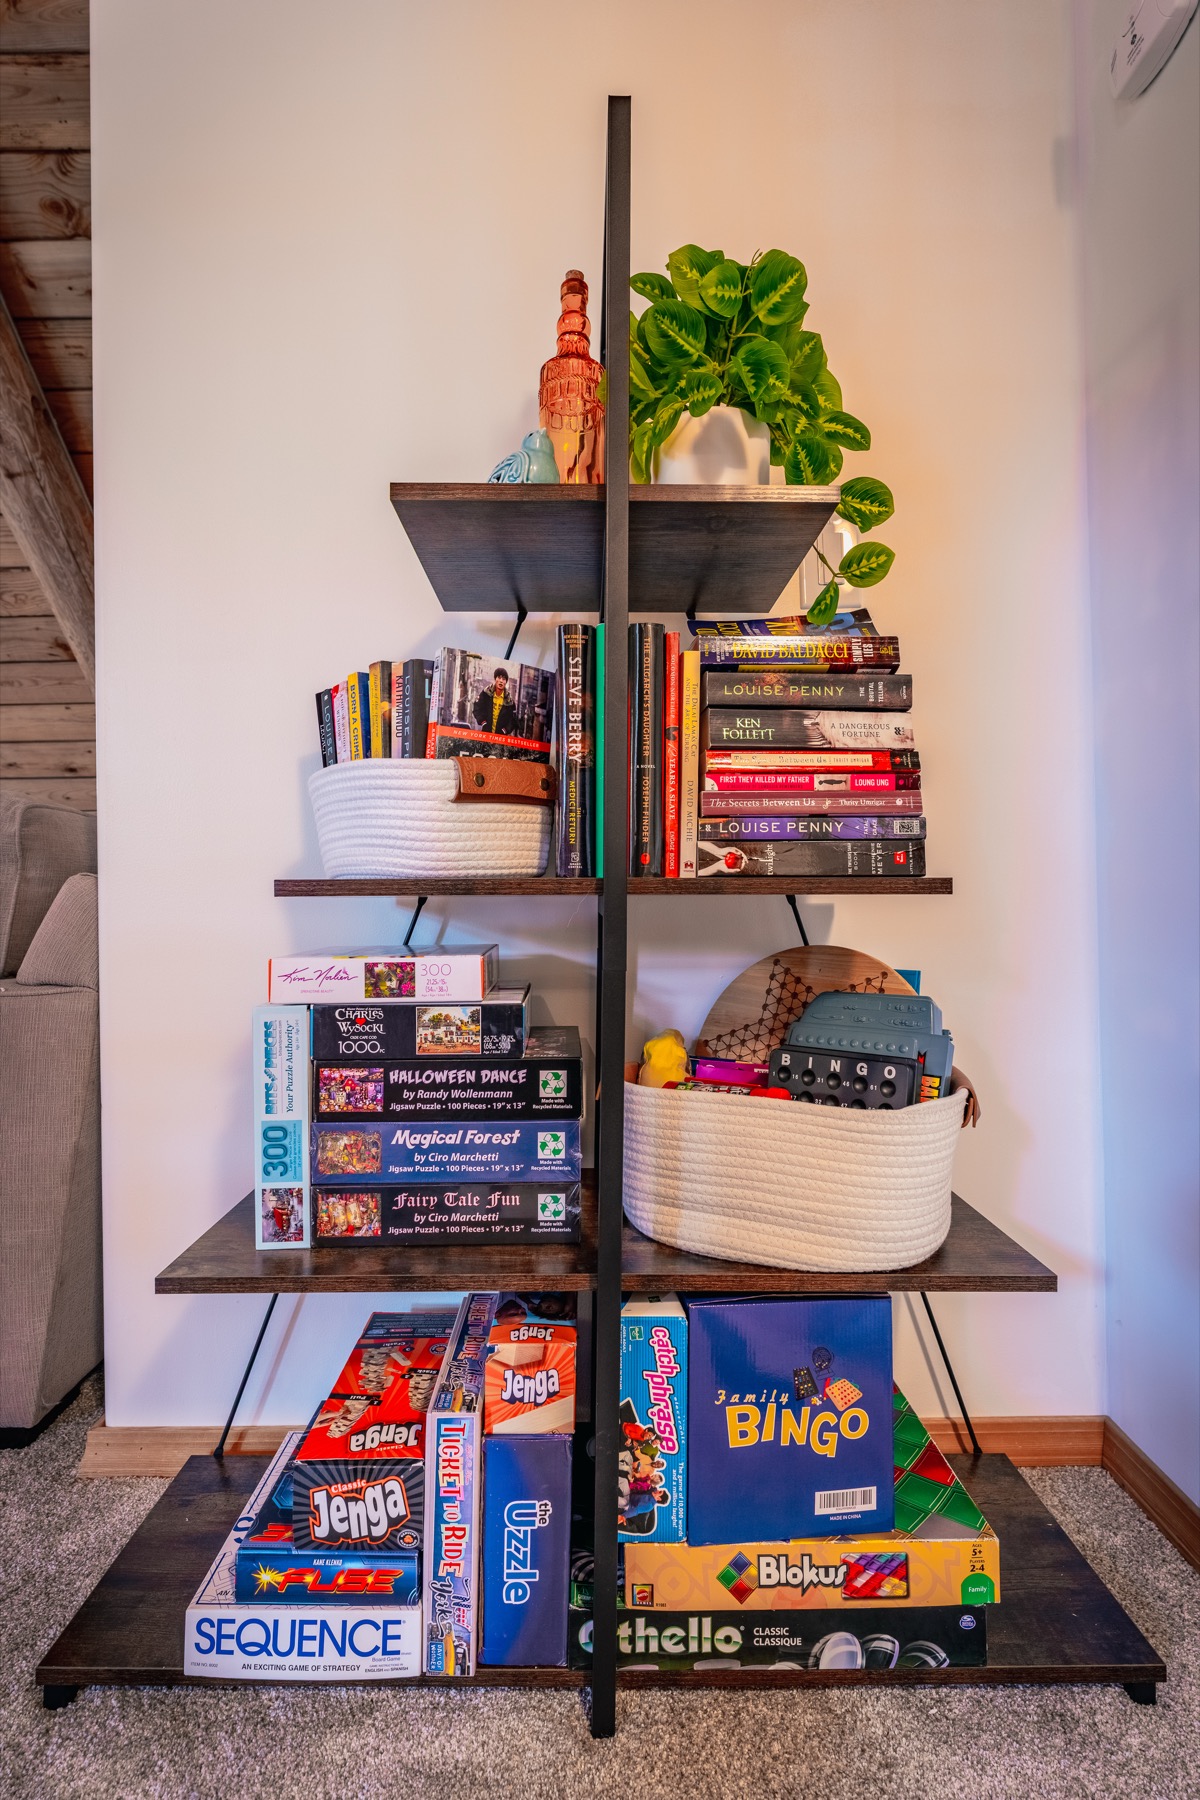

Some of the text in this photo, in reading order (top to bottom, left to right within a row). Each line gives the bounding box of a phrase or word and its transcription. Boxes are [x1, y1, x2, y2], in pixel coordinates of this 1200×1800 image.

[733, 642, 777, 658] DAVID
[778, 642, 849, 658] BALDACCI
[852, 638, 863, 662] SIMPLY
[863, 643, 873, 658] LIES
[643, 637, 651, 757] THE OLIGARCH'S DAUGHTER
[724, 684, 845, 697] LOUISE PENNY
[350, 684, 358, 714] BORN
[395, 674, 404, 739] KATHMANDU
[568, 656, 582, 763] STEVE BERRY
[352, 717, 358, 725] A
[736, 718, 762, 729] KEN
[831, 723, 890, 731] A DANGEROUS
[453, 729, 540, 749] NEW YORK TIMES BESTSELLER
[723, 728, 776, 741] FOLLETT
[842, 731, 881, 740] FORTUNE
[719, 776, 737, 784] FIRST
[739, 776, 754, 784] THEY
[755, 776, 776, 784] KILLED
[855, 778, 889, 787] LOUNG UNG
[642, 776, 651, 843] JOSEPH FINDER
[710, 798, 816, 807] The Secrets Between Us
[569, 780, 577, 844] MEDICI RETURN
[719, 821, 845, 833] LOUISE PENNY
[420, 963, 452, 977] 300
[263, 1021, 278, 1115] BITS PIECES
[389, 1069, 528, 1085] HALLOWEEN DANCE
[403, 1089, 513, 1100] by Randy Wollenmann
[391, 1130, 521, 1149] Magical Forest
[262, 1126, 289, 1178] 300
[414, 1152, 499, 1164] by Ciro Marchetti
[388, 1165, 413, 1173] Jigsaw
[415, 1165, 440, 1173] Puzzle
[446, 1165, 459, 1173] 100
[392, 1191, 521, 1210] Fairy Tale Fun
[414, 1212, 499, 1224] by Ciro Marchetti
[509, 1326, 555, 1342] Jenga
[650, 1326, 681, 1378] catch
[501, 1368, 560, 1406] Jenga
[714, 1389, 790, 1405] Family
[643, 1371, 679, 1453] phrase
[350, 1423, 423, 1453] Jenga
[725, 1403, 870, 1459] BINGO
[331, 1478, 367, 1493] Classic
[438, 1421, 470, 1578] TICKET TO RIDE
[312, 1479, 407, 1540] Jenga
[538, 1500, 552, 1527] the
[502, 1500, 540, 1605] Uzzle
[971, 1548, 983, 1557] 5+
[758, 1554, 848, 1592] Blokus
[970, 1564, 985, 1572] 2-4
[278, 1567, 403, 1593] FUSE
[968, 1586, 988, 1594] Family
[194, 1617, 402, 1658] SEQUENCE
[753, 1627, 790, 1636] CLASSIC
[753, 1637, 803, 1646] CLASSIQUE
[242, 1663, 361, 1672] AN EXCITING GAME OF STRATEGY
